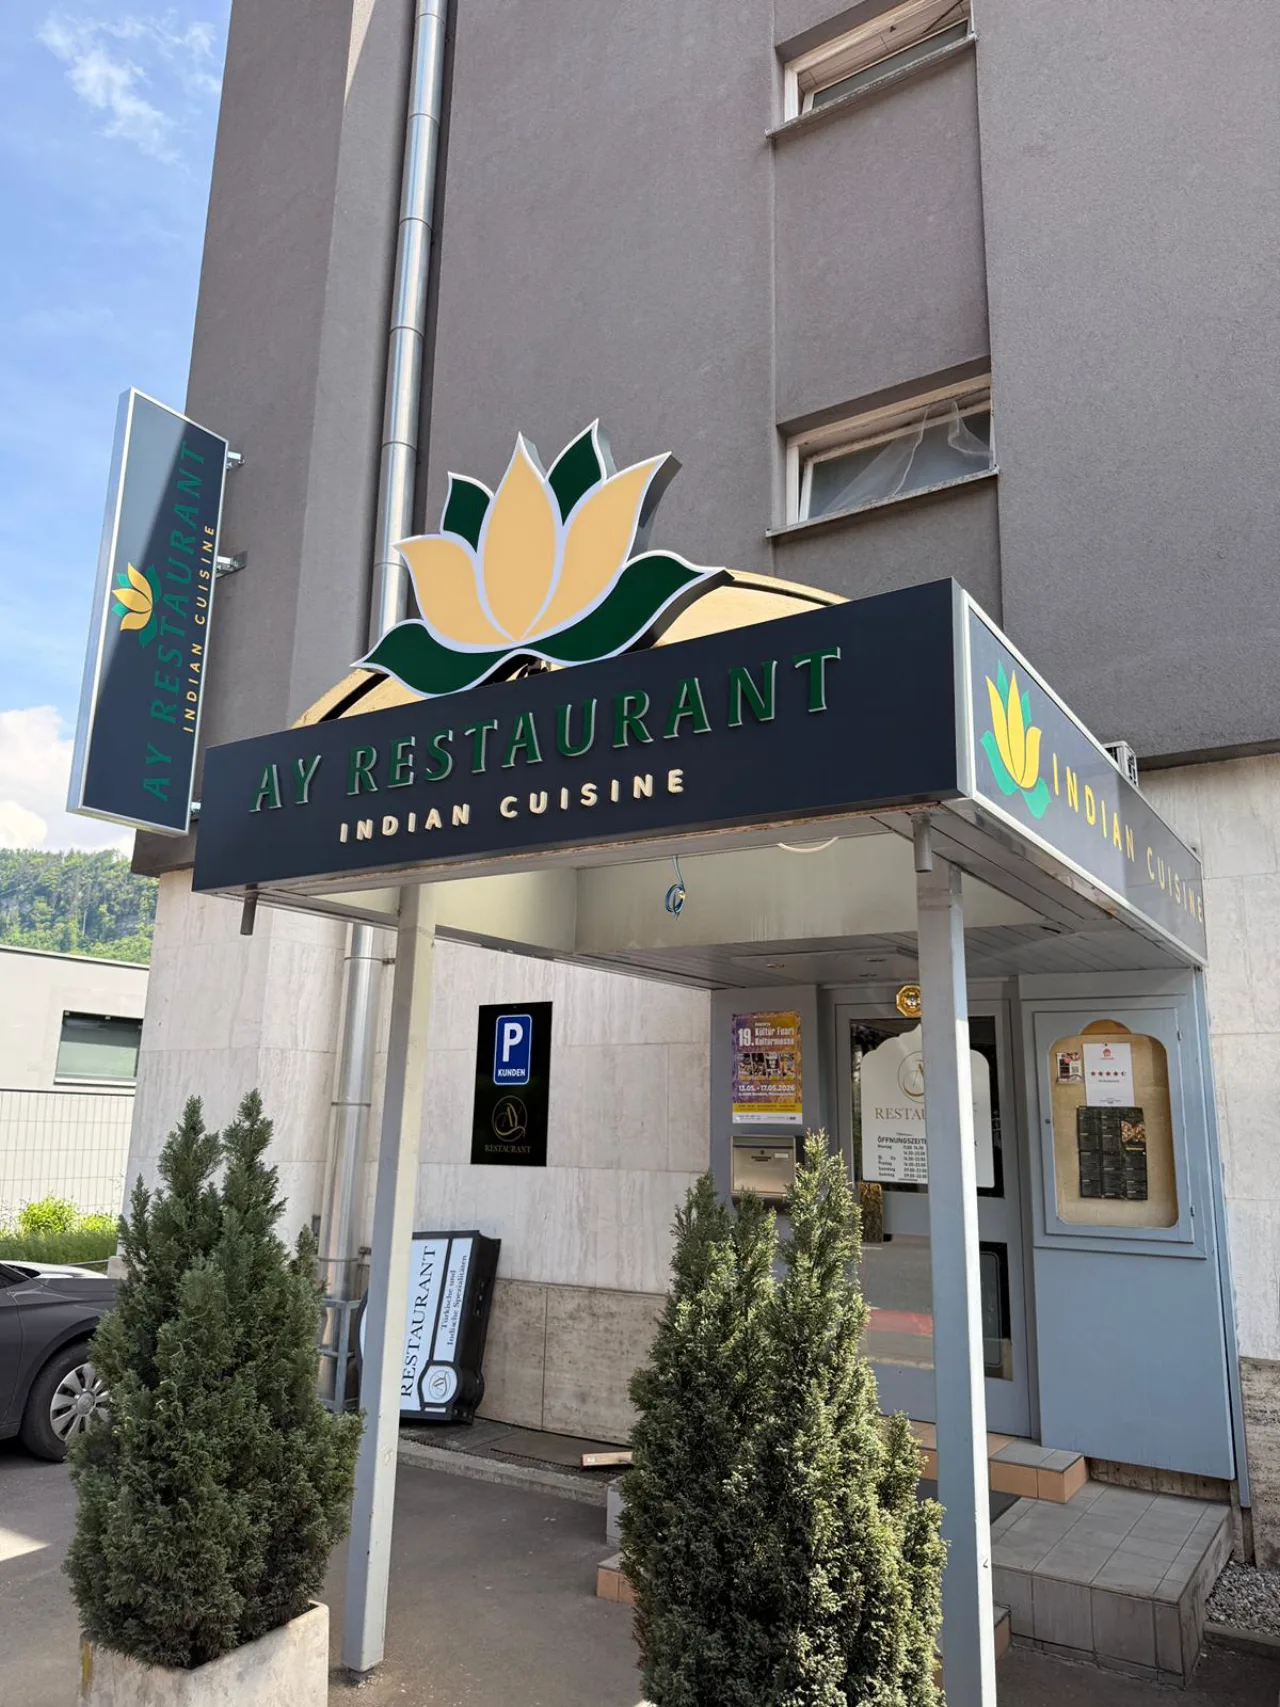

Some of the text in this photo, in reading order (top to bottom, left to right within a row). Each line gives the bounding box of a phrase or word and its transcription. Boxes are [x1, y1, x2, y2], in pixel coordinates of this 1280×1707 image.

[143, 441, 206, 801] AY RESTAURANT
[183, 525, 215, 733] INDIAN CUISINE
[249, 646, 841, 813] AY RESTAURANT
[339, 768, 685, 843] INDIAN CUISINE
[1053, 752, 1203, 923] INDIAN CUISINE
[498, 1068, 526, 1077] KUNDEN
[502, 1022, 524, 1062] P
[484, 1144, 532, 1153] RESTAURANT
[400, 1245, 436, 1397] RESTAURANT
[440, 1269, 457, 1330] Türkische und
[446, 1255, 468, 1346] Indische Spezialitäten
